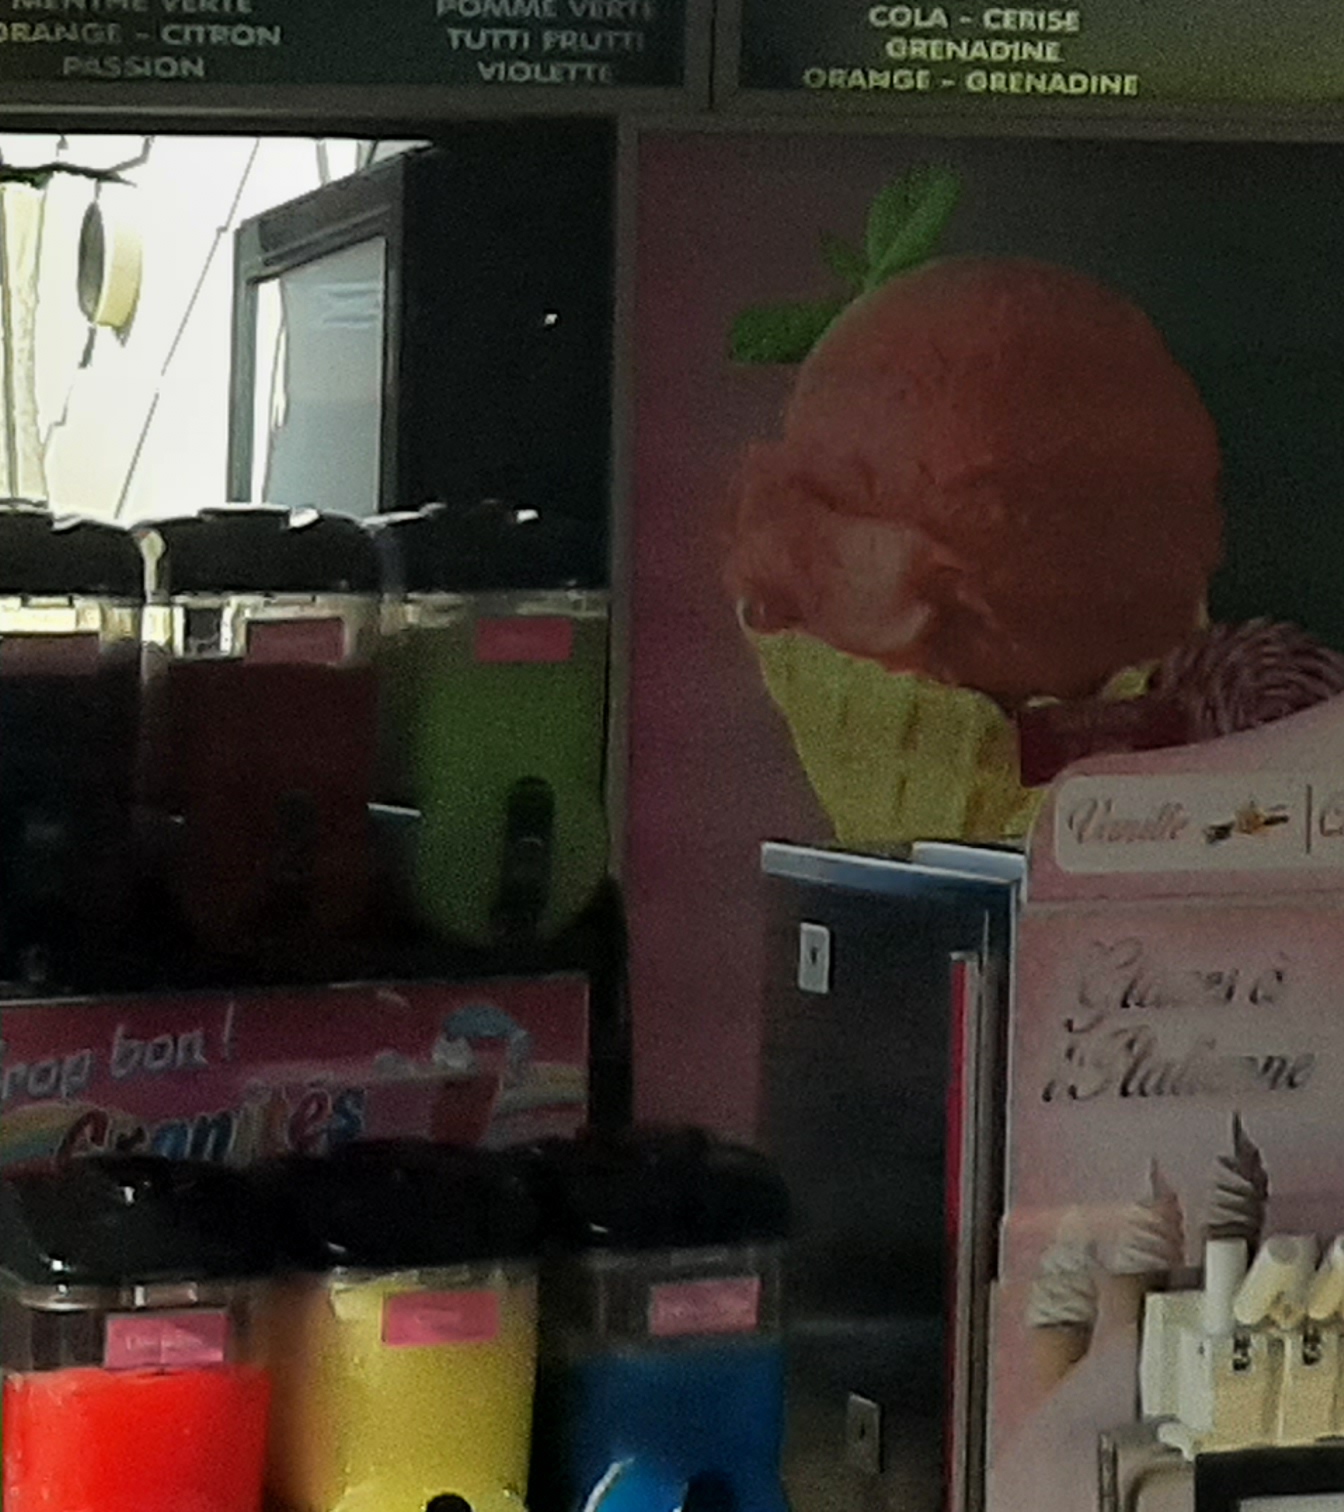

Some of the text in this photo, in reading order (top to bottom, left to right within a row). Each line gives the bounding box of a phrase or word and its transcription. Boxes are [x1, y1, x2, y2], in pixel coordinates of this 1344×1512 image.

[868, 4, 949, 29] COLA
[983, 7, 1083, 33] CERISE
[160, 23, 282, 47] CITRON
[446, 27, 645, 53] TUTTI FRUTTI
[885, 35, 1066, 65] GRENADINE
[63, 55, 206, 79] PASSION
[476, 60, 612, 84] VIOLETTE
[802, 65, 932, 91] ORANGE
[965, 68, 1141, 97] GRENADINE
[0, 1038, 95, 1101] rop
